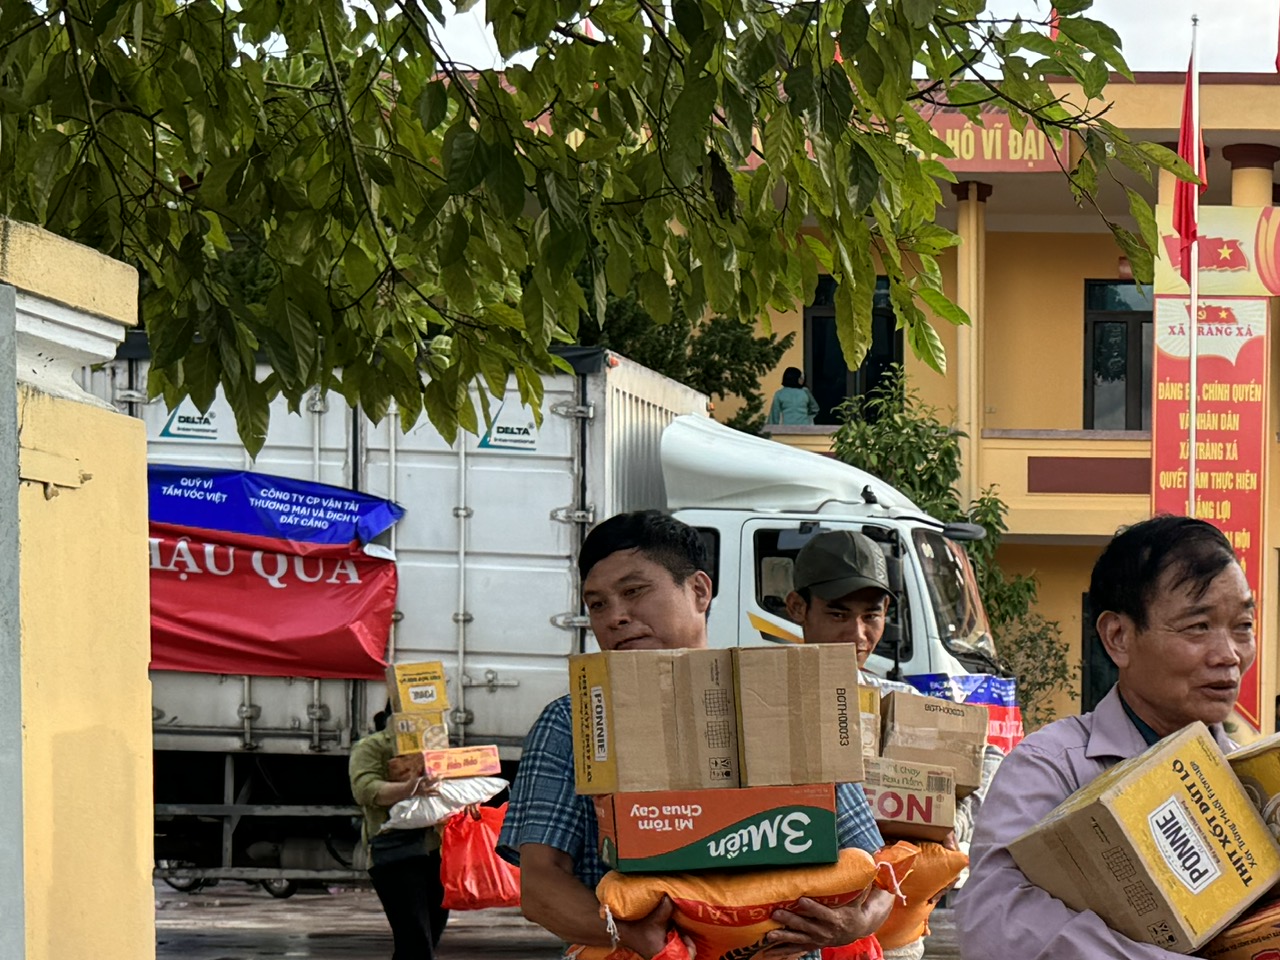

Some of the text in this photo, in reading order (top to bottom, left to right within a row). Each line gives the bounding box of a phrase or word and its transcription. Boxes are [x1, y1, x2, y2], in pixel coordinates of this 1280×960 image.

[981, 122, 1003, 160] VĨ
[1008, 129, 1045, 167] ĐẠI
[1168, 323, 1253, 337] XÃ RÀNG XÁ
[1158, 377, 1183, 400] ĐẢNG
[1202, 380, 1231, 402] CHÍNH
[178, 415, 211, 425] DELTA
[1220, 410, 1240, 431] DÂN
[496, 426, 531, 436] DELTA
[1160, 466, 1258, 494] QUYẾT ÂM THỰC HIỆN
[249, 497, 291, 512] THƯƠNG
[260, 488, 291, 501] CÔNG
[292, 493, 305, 503] TY
[305, 496, 321, 506] CP
[630, 804, 702, 818] Chua Cay
[638, 818, 694, 832] Mì Tôm
[1156, 810, 1209, 884] PÖNNIE
